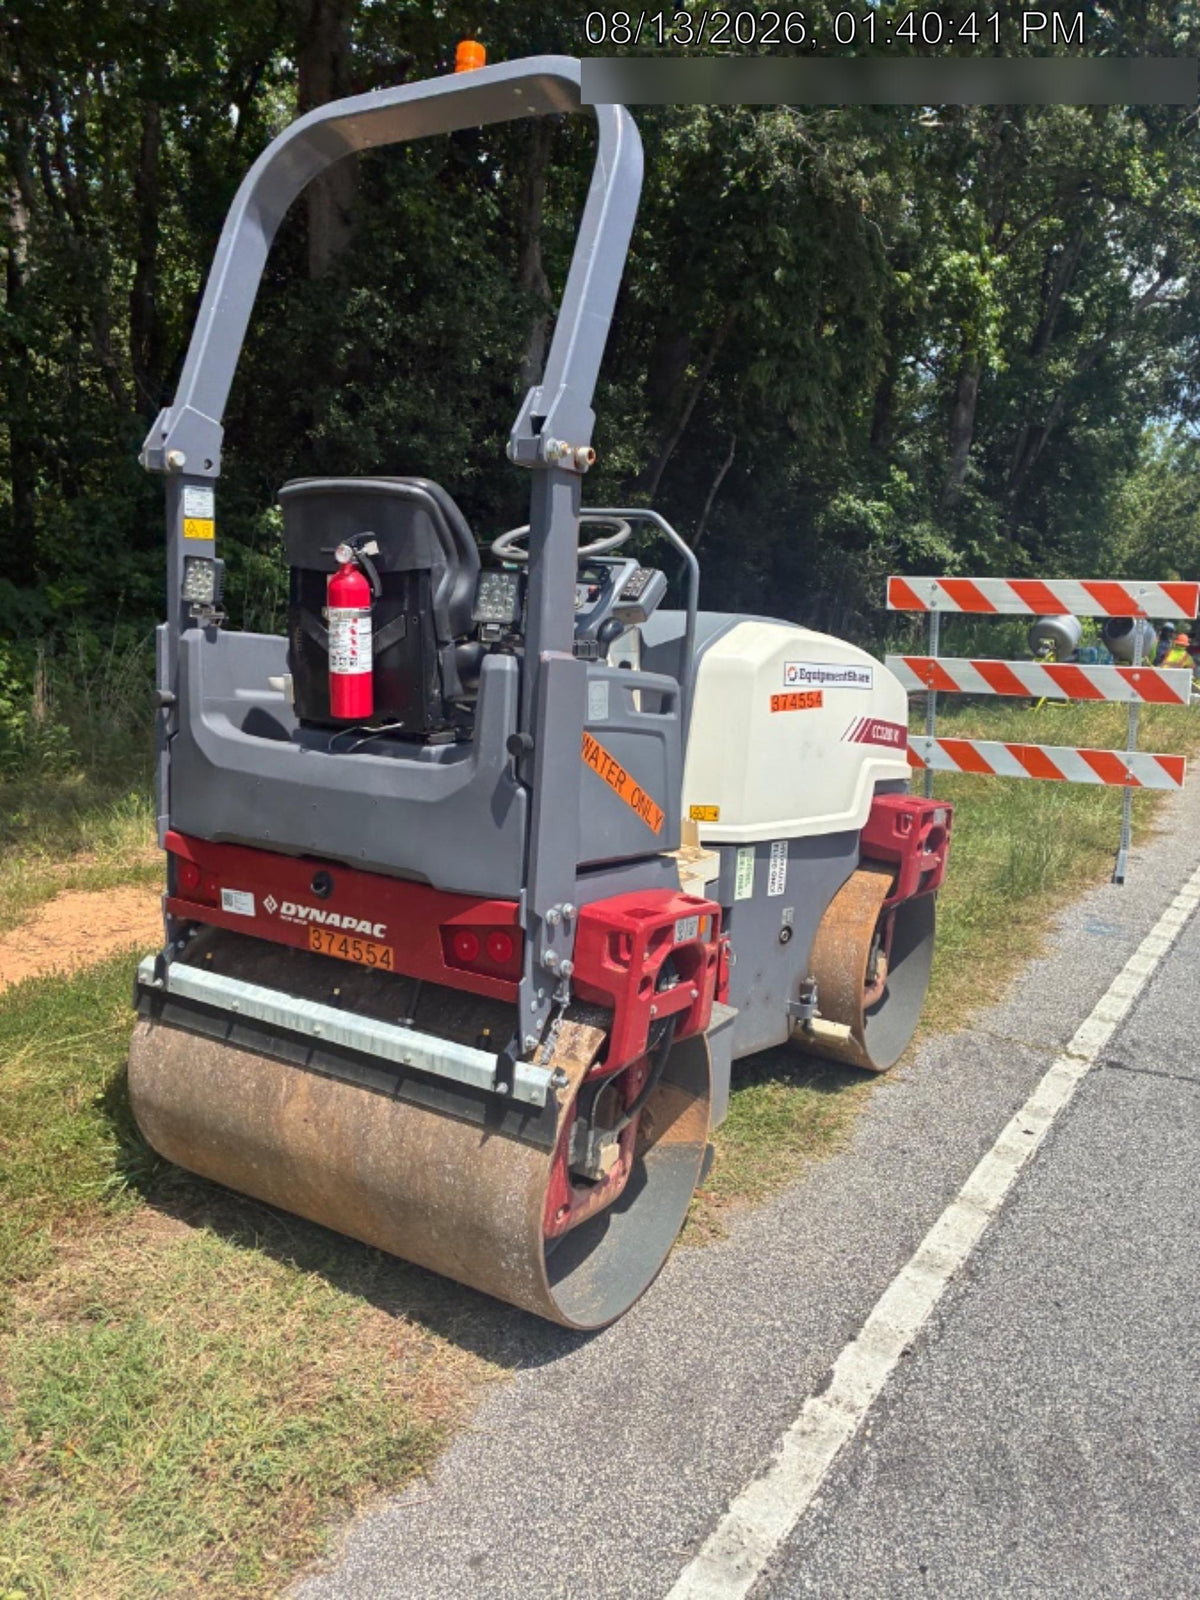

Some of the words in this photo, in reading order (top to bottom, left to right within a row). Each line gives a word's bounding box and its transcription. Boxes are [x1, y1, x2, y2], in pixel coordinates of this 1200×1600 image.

[799, 668, 870, 683] EquipmentShare
[771, 692, 823, 712] 374554
[582, 734, 627, 793] WATER
[630, 787, 664, 830] ONLY
[280, 901, 388, 938] DYNAPAC
[311, 928, 393, 969] 374554
